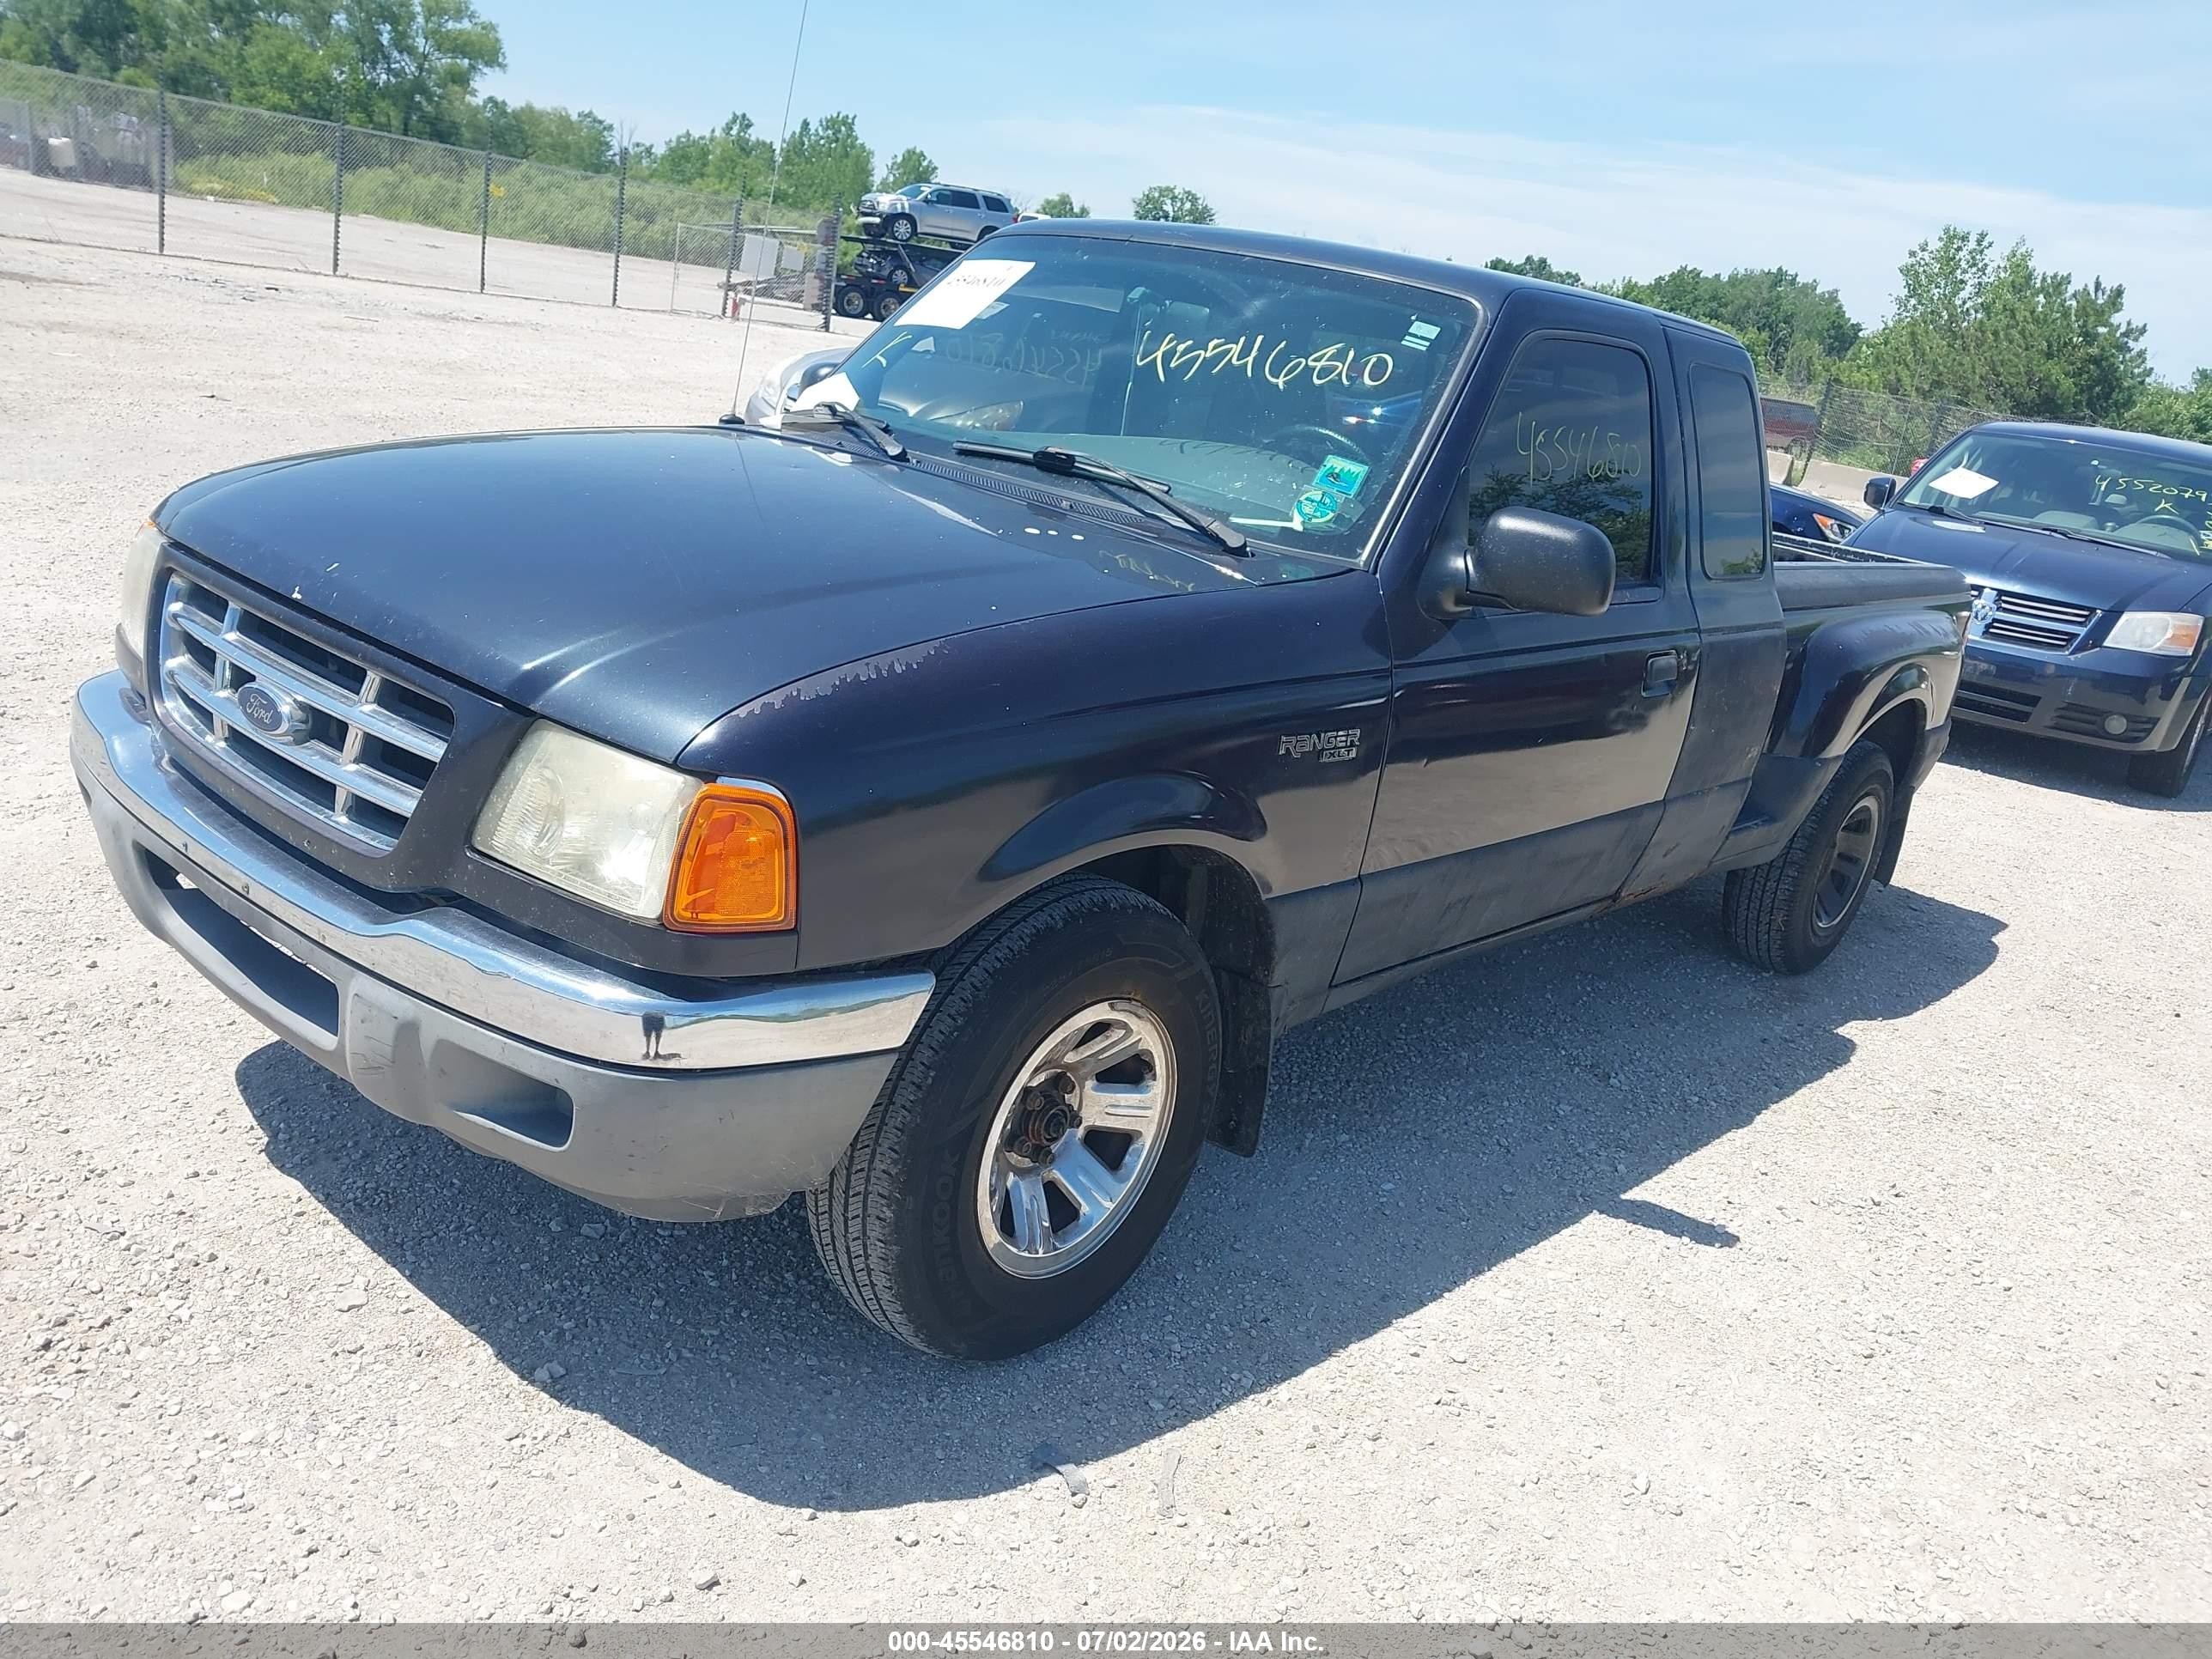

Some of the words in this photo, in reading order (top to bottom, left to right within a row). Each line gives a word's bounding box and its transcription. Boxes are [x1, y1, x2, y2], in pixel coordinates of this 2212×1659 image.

[1135, 331, 1394, 392] 45546810
[1516, 411, 1641, 487] 45546810
[2154, 498, 2179, 515] K
[246, 693, 274, 724] Ford
[1279, 728, 1361, 757] RANGER
[1325, 748, 1356, 761] XLT
